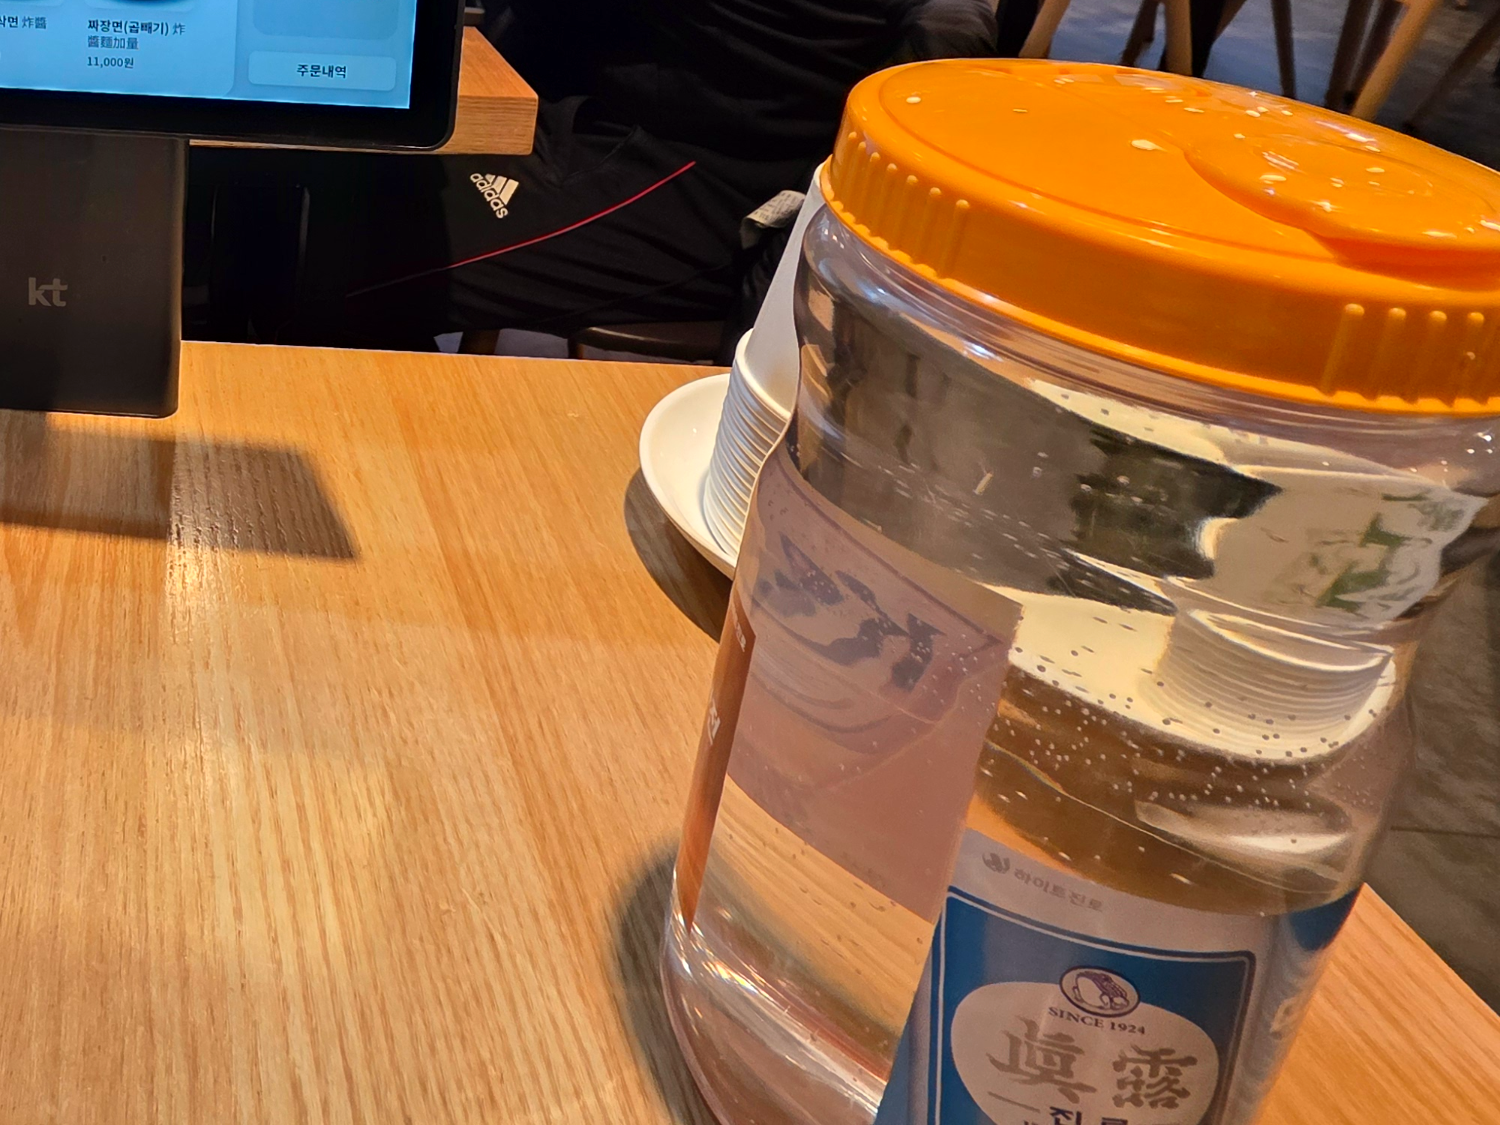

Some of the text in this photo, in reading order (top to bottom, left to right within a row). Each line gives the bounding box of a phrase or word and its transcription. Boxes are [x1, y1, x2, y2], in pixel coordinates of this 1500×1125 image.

[87, 56, 134, 69] 11,000원
[297, 64, 347, 79] 주문내역
[470, 173, 509, 219] adidas
[28, 277, 68, 307] kt
[1048, 1006, 1146, 1036] SINCE 1924
